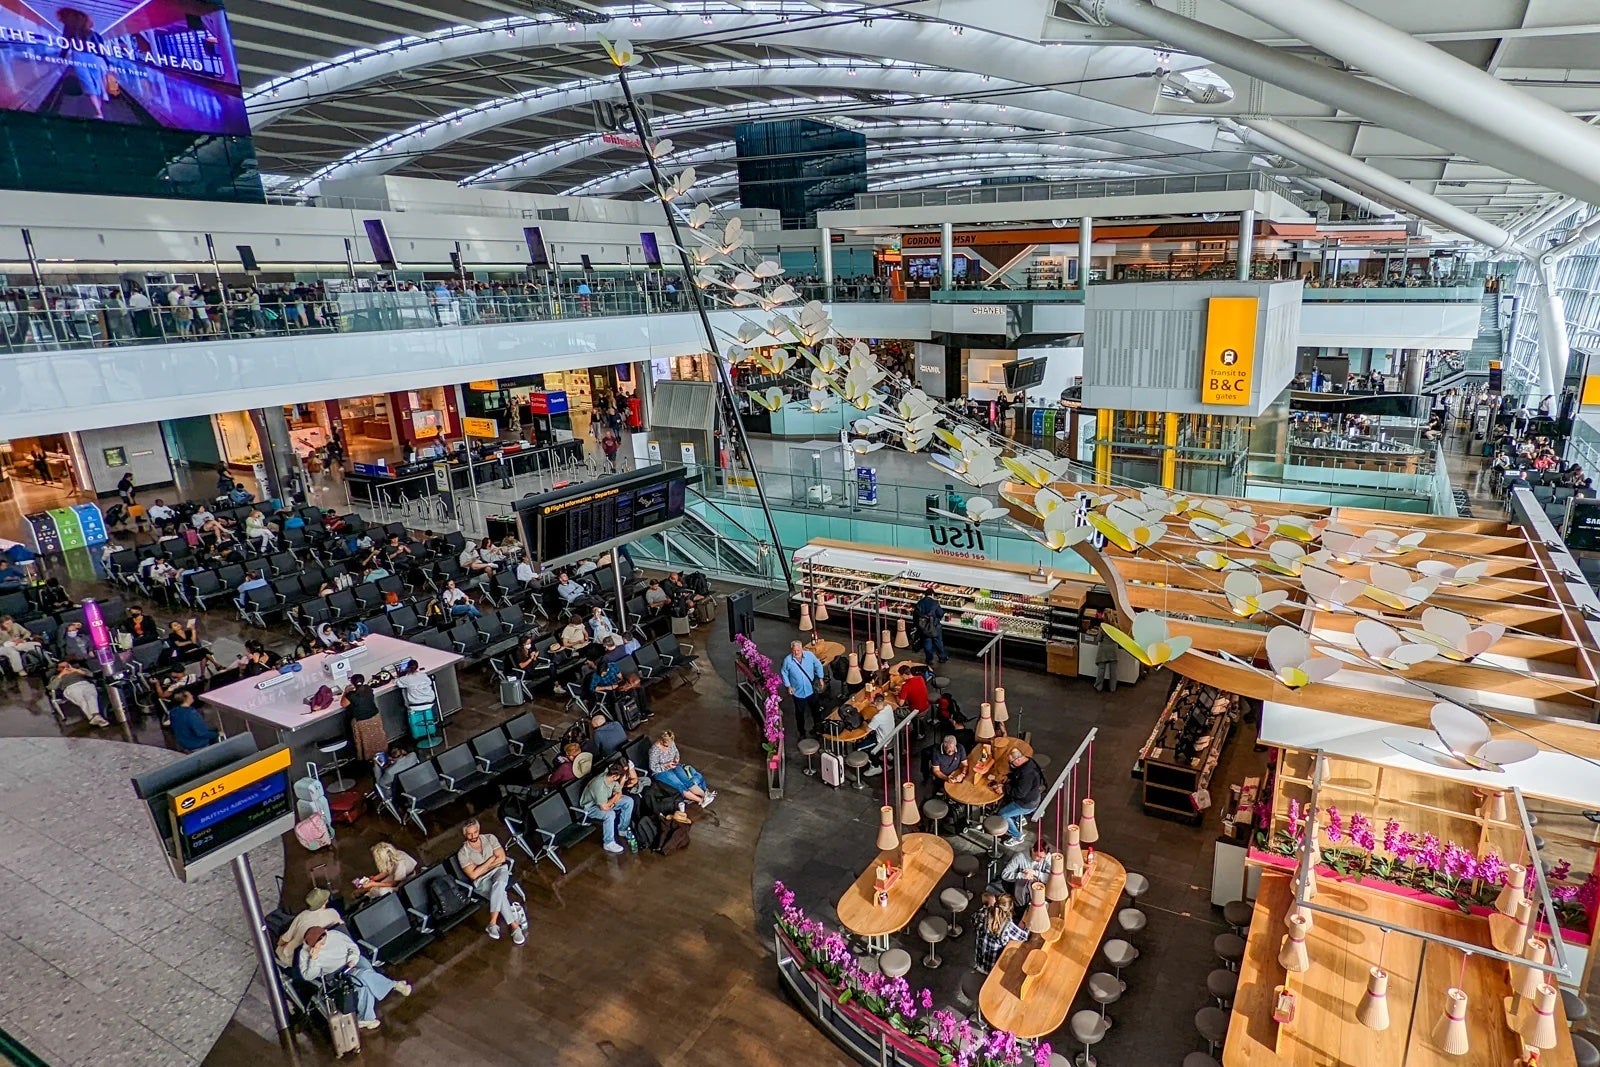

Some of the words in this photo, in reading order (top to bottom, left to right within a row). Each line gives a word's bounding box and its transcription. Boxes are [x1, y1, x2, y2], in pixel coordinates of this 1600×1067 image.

[0, 26, 37, 44] THE
[47, 34, 136, 60] JOURNEY
[144, 51, 204, 72] AHEAD
[23, 51, 42, 62] The
[45, 56, 97, 69] excitement
[128, 67, 148, 78] here
[907, 237, 940, 246] GORDON
[972, 306, 1005, 315] CHANEL
[1210, 378, 1219, 390] B
[1221, 379, 1231, 391] &
[1234, 379, 1244, 391] C
[550, 503, 565, 511] Flight
[594, 488, 619, 499] Departures
[906, 568, 921, 578] itsu
[200, 783, 225, 801] A15
[200, 807, 230, 824] BRITISH
